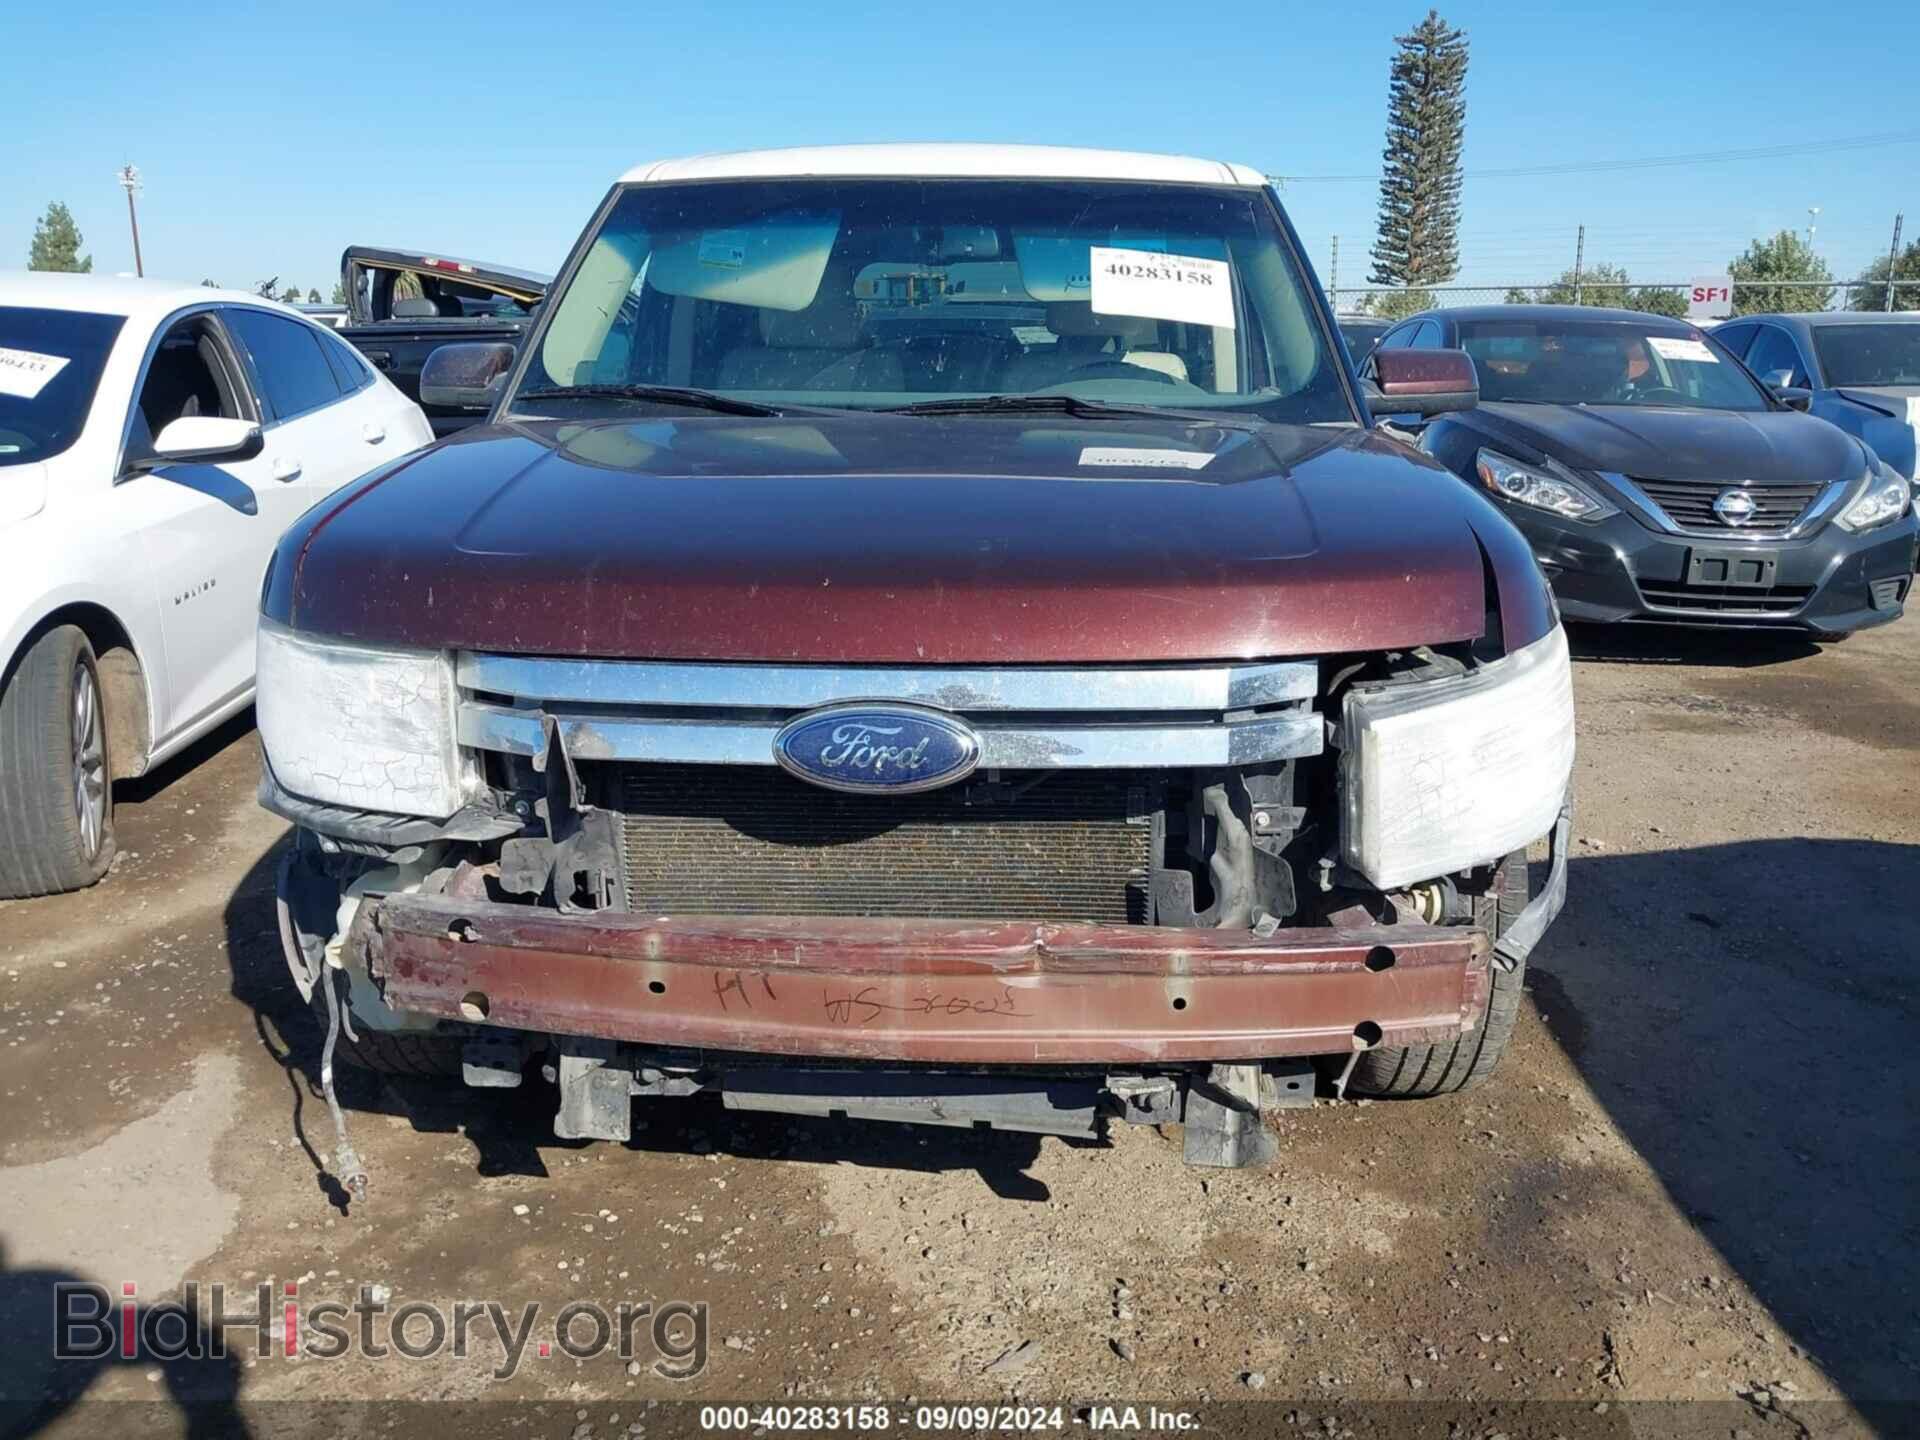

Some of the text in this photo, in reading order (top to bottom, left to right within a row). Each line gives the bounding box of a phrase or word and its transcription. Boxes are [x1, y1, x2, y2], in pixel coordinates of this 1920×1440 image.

[1105, 263, 1213, 286] 40283158
[1692, 287, 1728, 302] SF1
[821, 724, 930, 774] Ford
